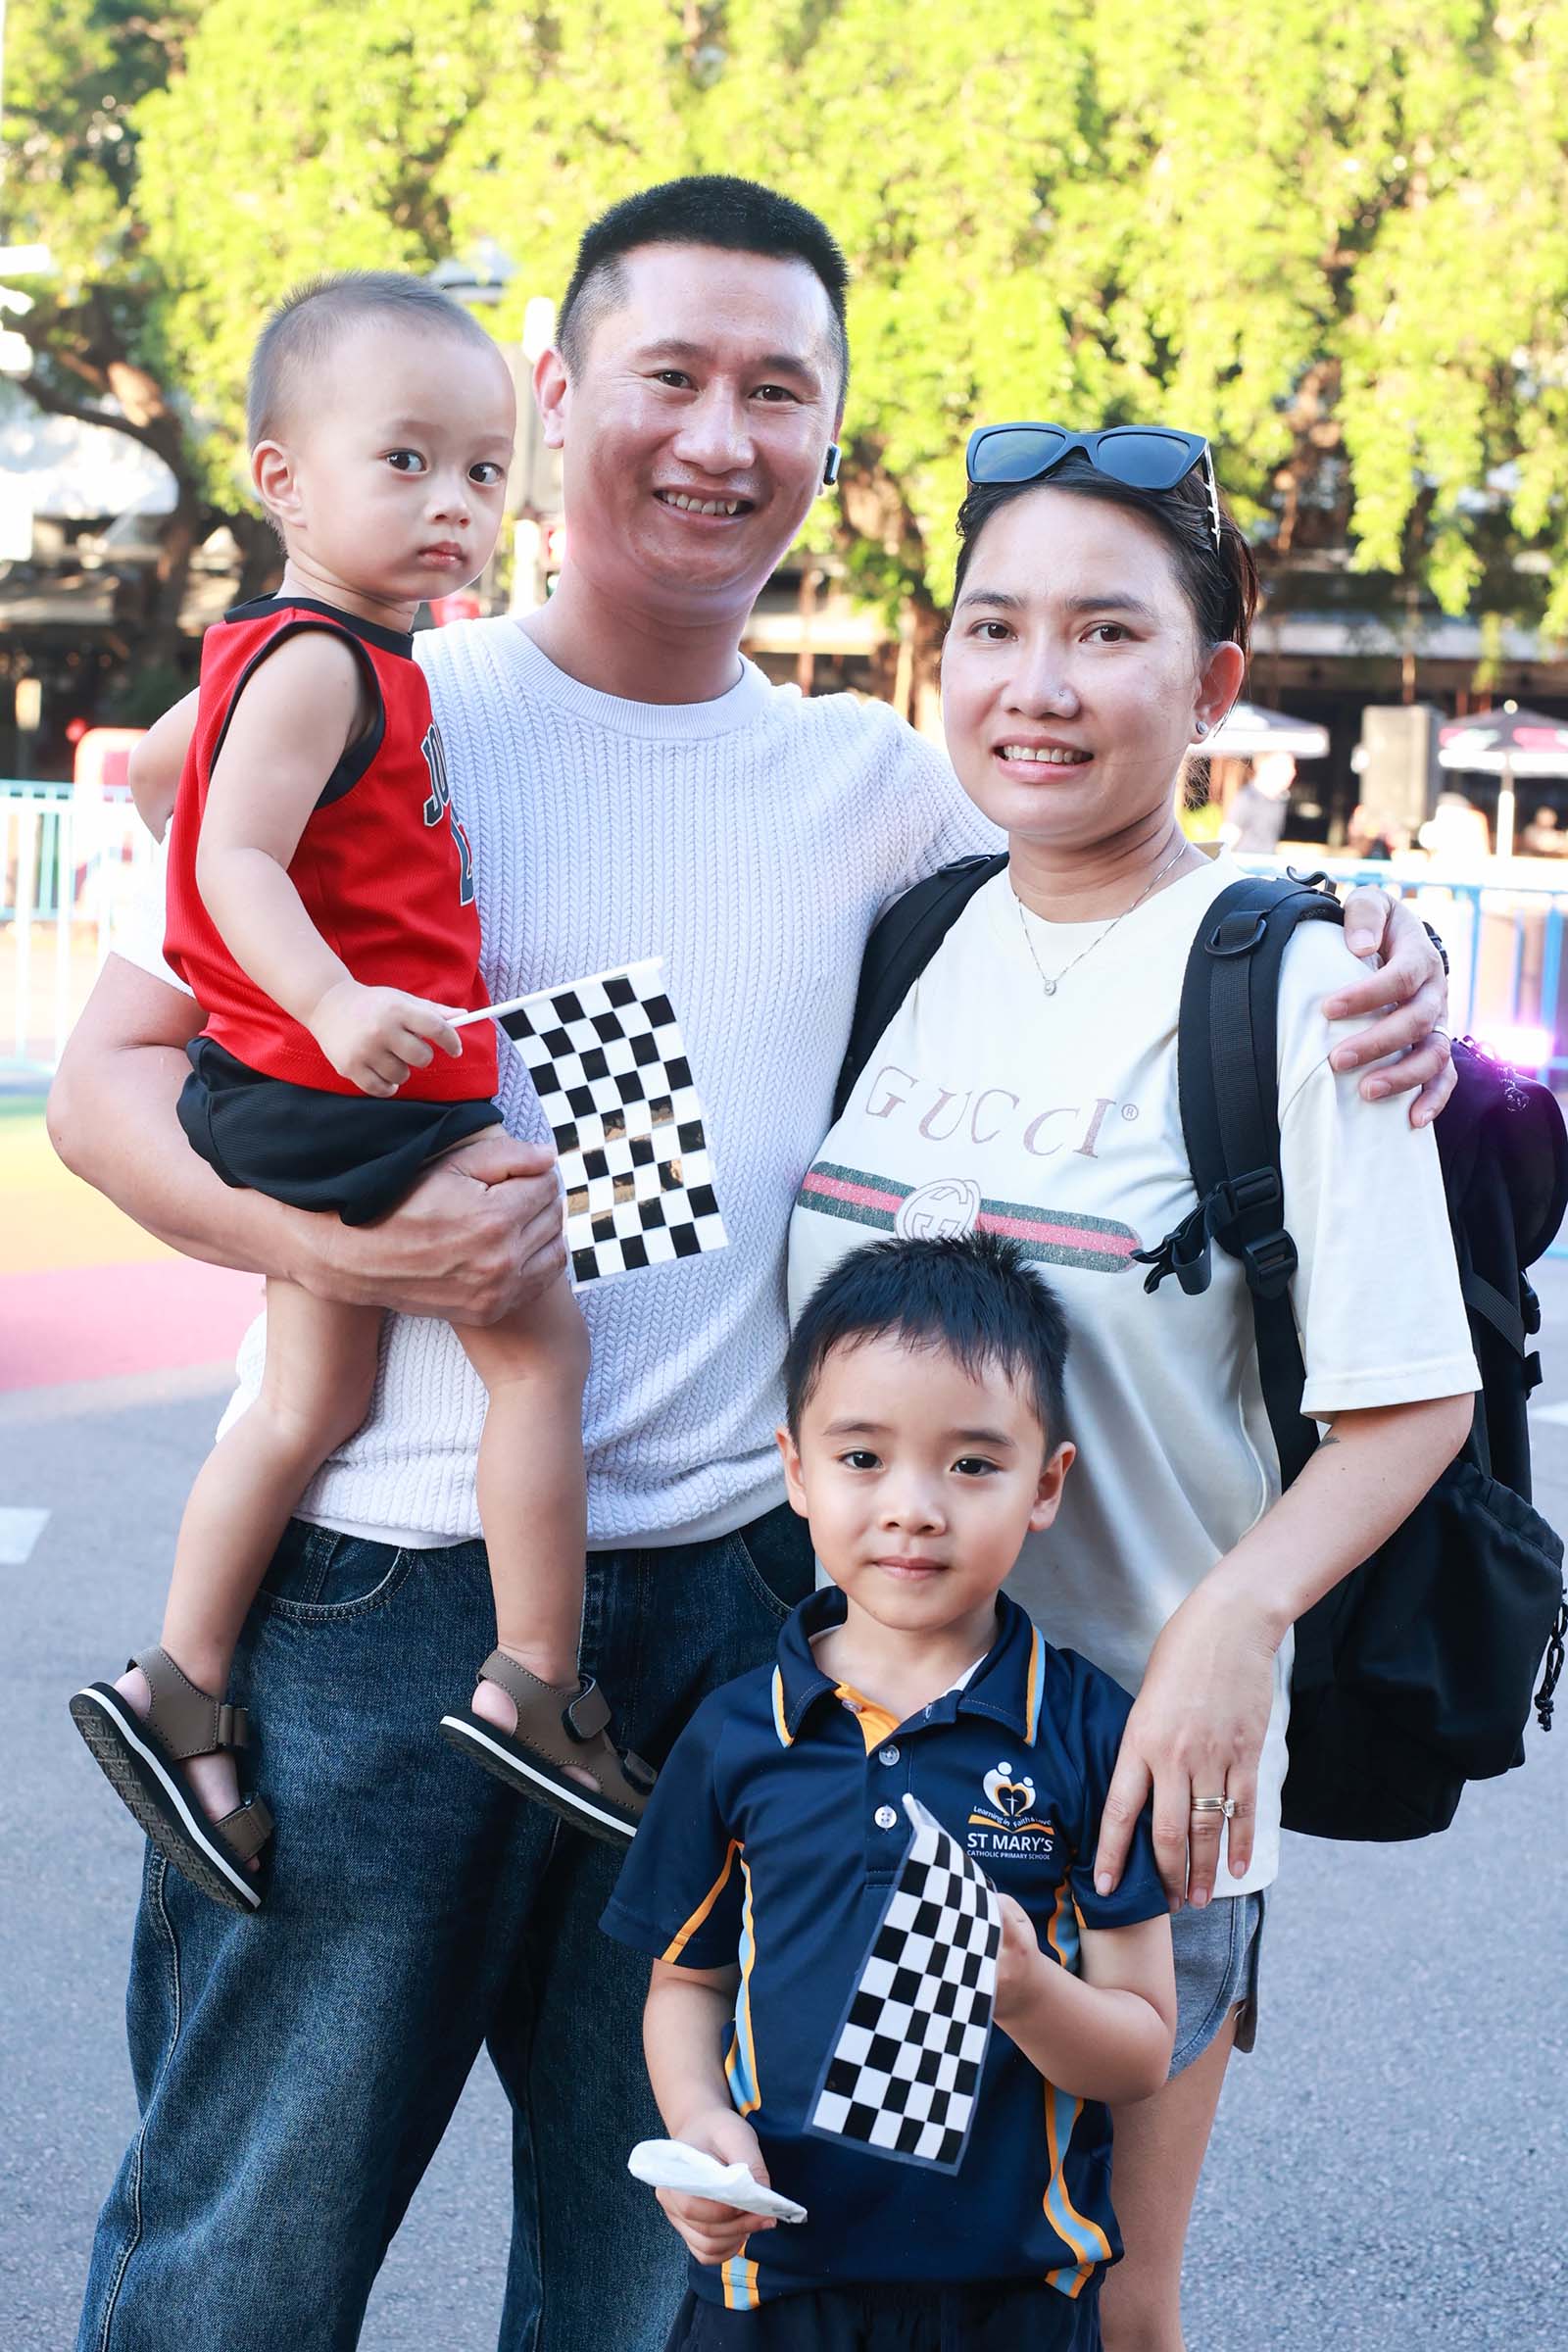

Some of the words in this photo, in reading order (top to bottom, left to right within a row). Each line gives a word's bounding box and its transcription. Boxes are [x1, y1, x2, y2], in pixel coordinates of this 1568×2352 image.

[973, 1805, 1003, 1825] Learning
[1013, 1816, 1030, 1828] Faith
[966, 1833, 989, 1848] ST
[993, 1834, 1054, 1852] MARY'S
[966, 1849, 1000, 1858] CATHOLIC
